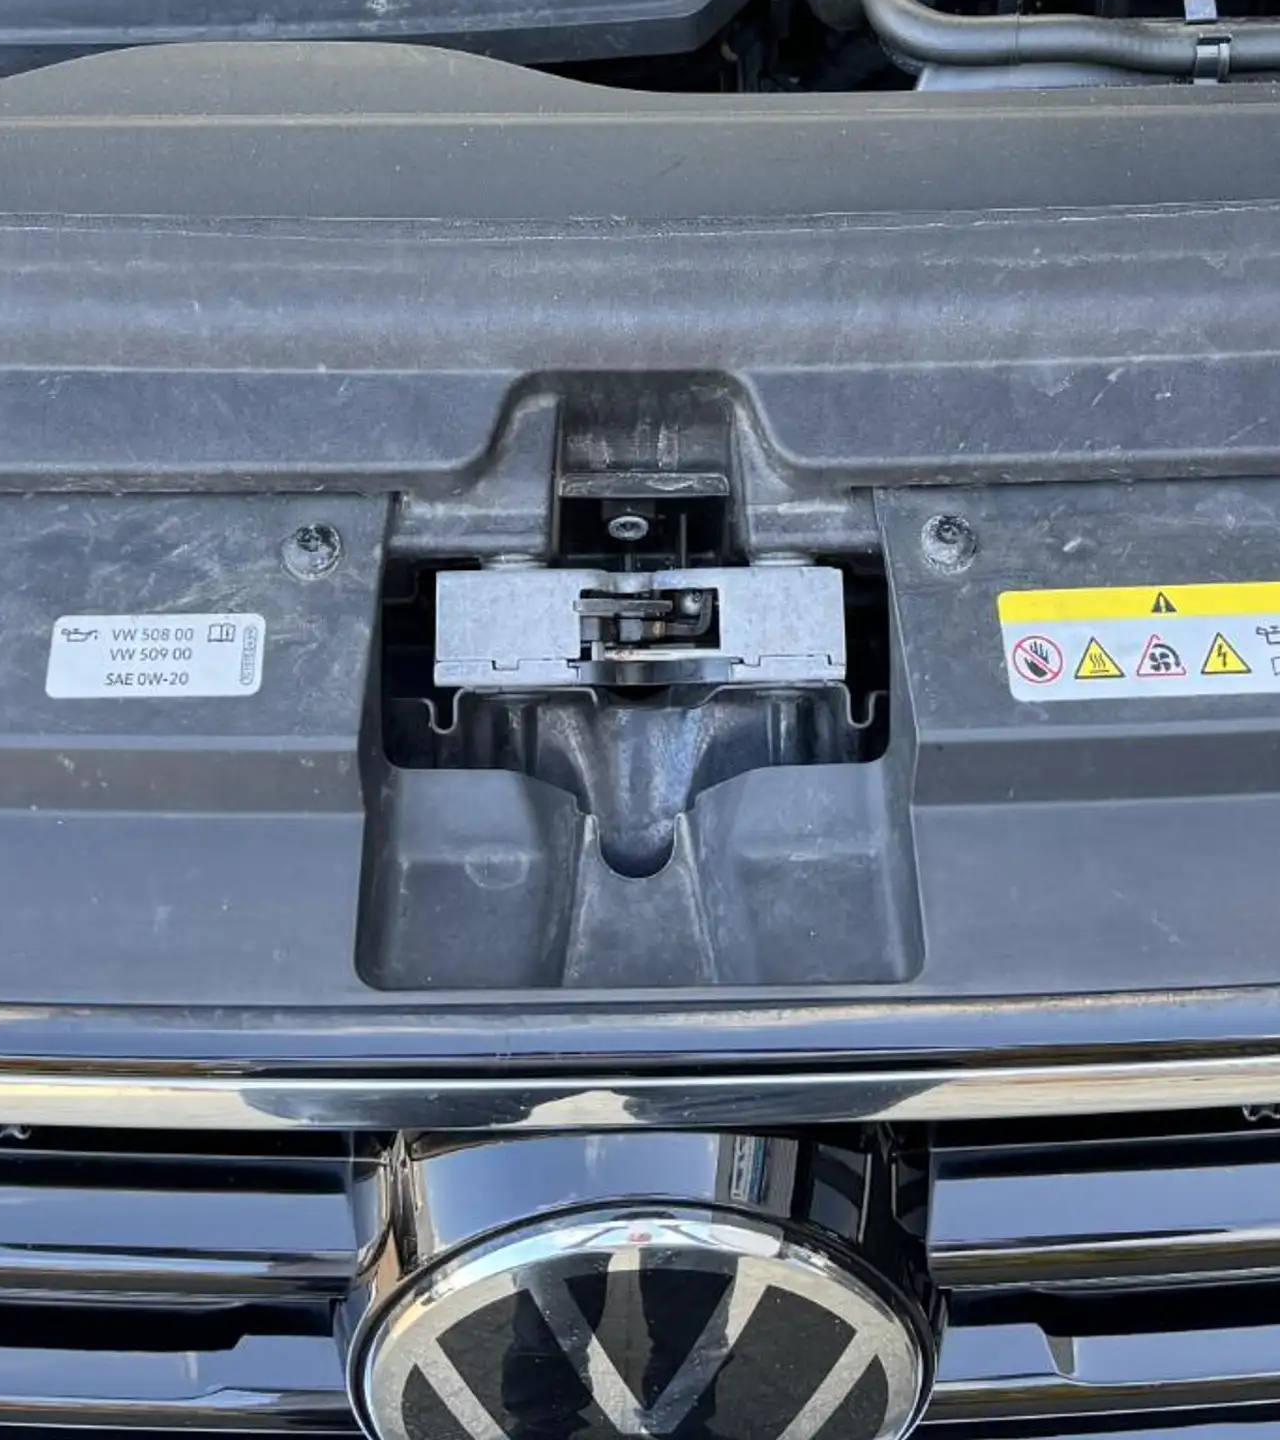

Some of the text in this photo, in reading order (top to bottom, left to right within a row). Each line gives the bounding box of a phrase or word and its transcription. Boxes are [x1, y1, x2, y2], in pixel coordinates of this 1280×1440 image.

[112, 627, 194, 642] VW 508 00
[110, 647, 193, 661] VW 509 00
[104, 672, 190, 686] SAE 0W-20
